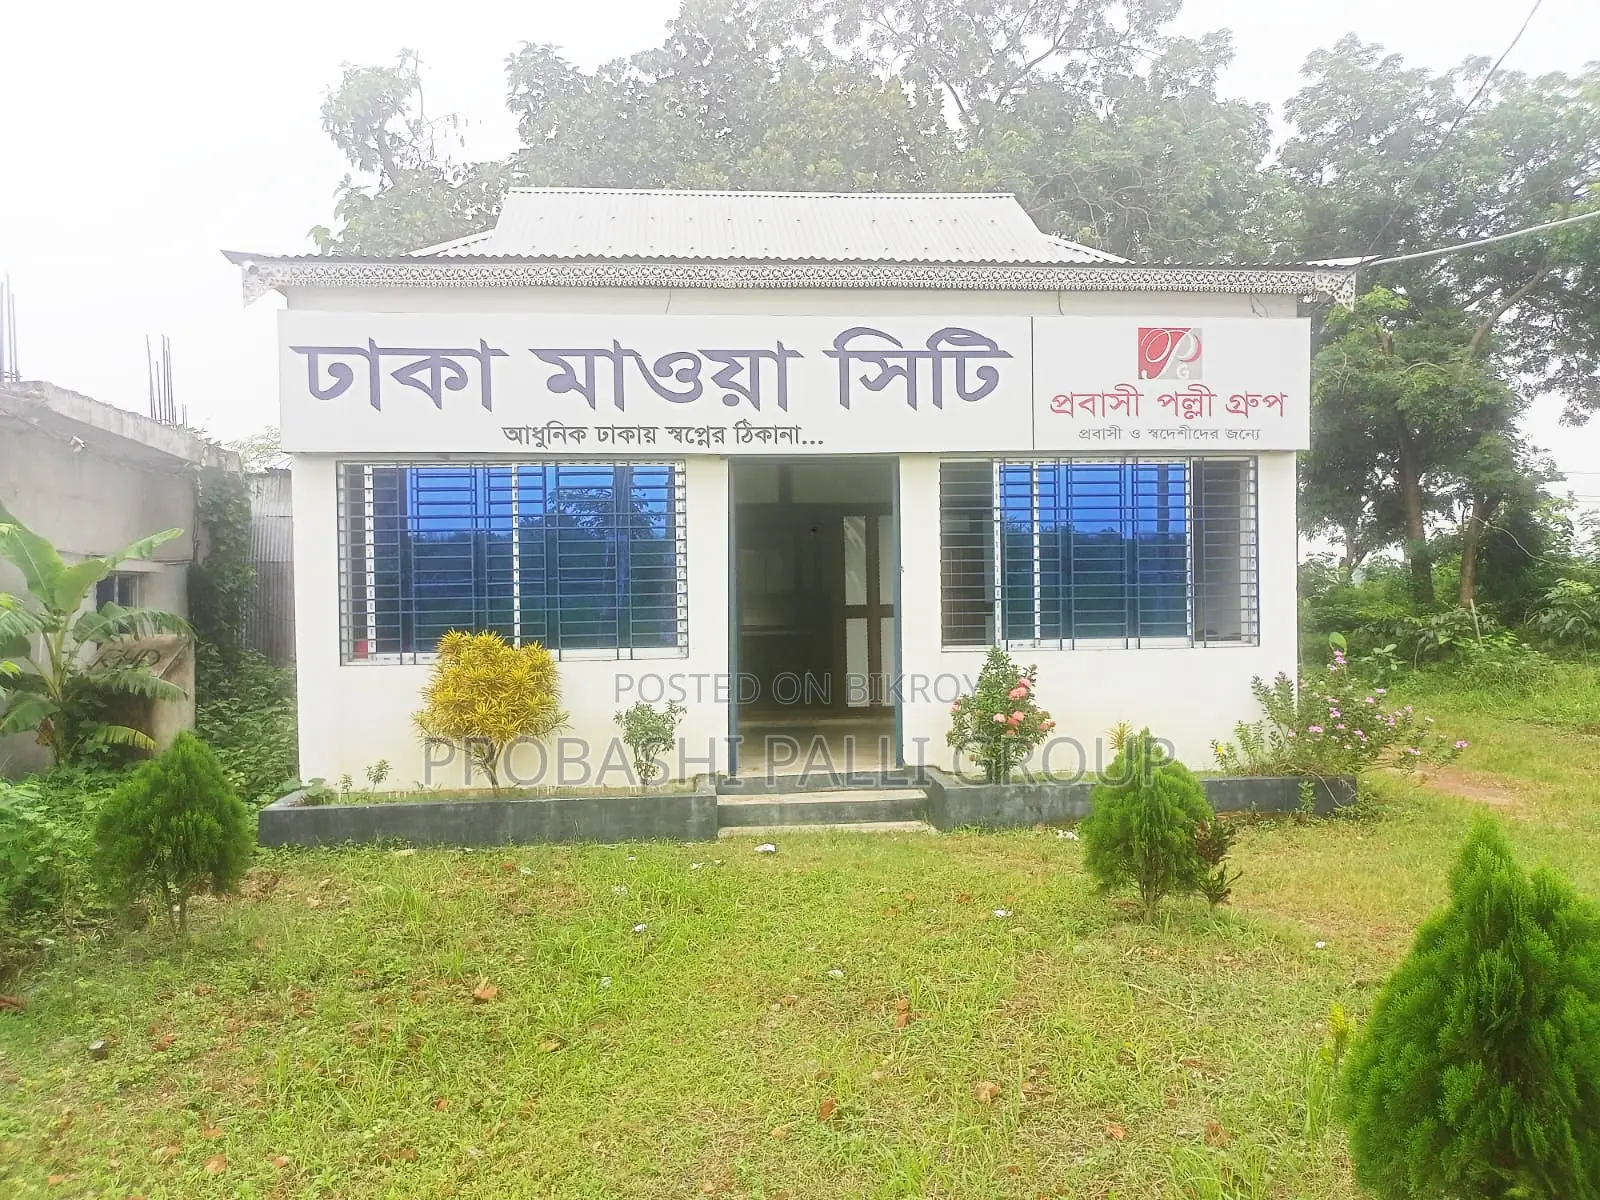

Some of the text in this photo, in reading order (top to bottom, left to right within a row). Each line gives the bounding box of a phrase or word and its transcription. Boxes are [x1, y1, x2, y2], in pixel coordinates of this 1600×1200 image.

[289, 326, 1014, 412] ঢাকা মাওয়া সিটি
[1050, 383, 1289, 420] প্রবাসী পল্লী গ্রুপ
[502, 420, 589, 449] আধুনিক
[594, 424, 659, 445] ঢাকায়
[664, 424, 728, 448] স্বপ্নের
[1078, 425, 1122, 441] প্রবাসী
[1129, 429, 1141, 440] ও
[1147, 425, 1219, 441] স্বদেশীদের
